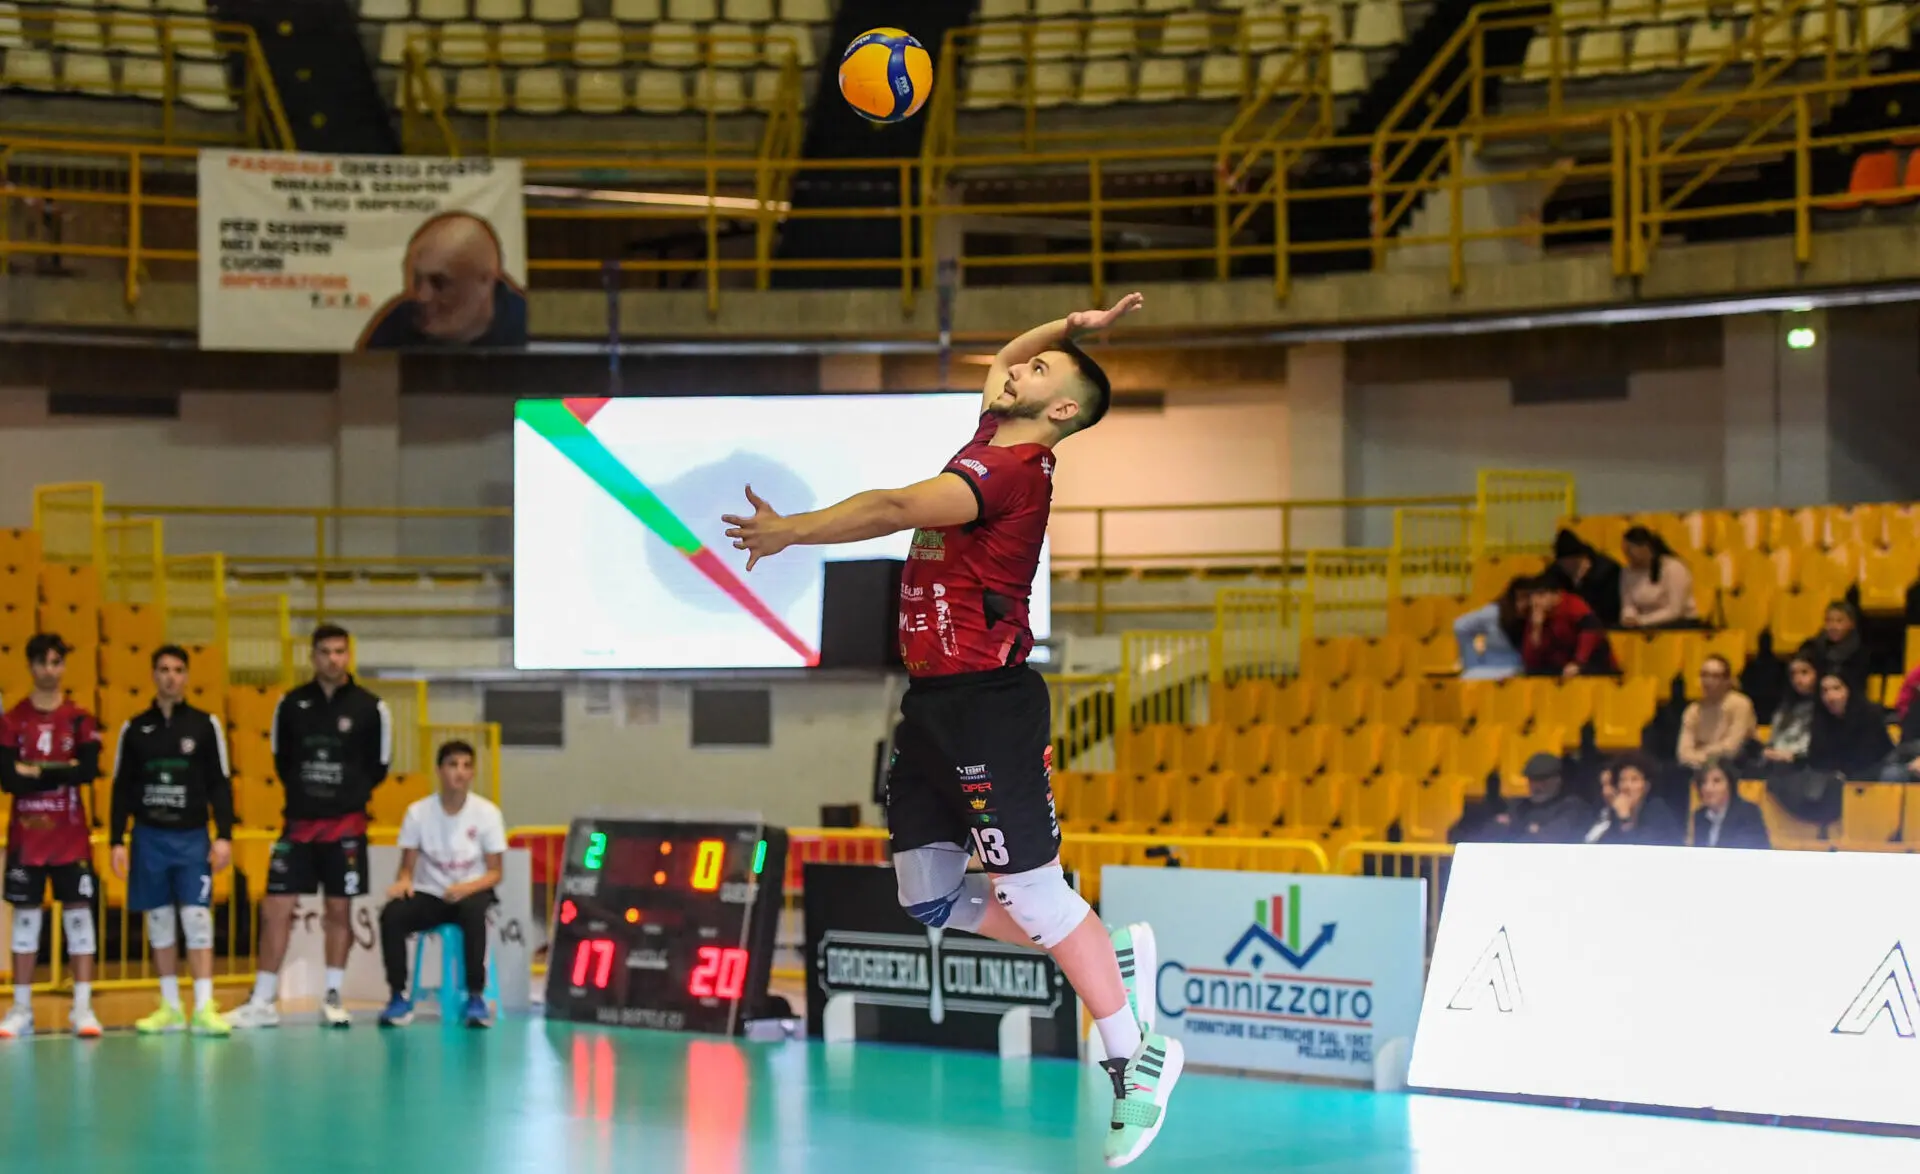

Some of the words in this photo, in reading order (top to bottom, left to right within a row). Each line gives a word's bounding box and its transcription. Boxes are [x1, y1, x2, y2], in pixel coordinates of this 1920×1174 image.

[219, 218, 258, 234] PER
[266, 221, 346, 238] SEMPRE
[37, 731, 52, 755] 4
[971, 827, 1010, 866] 13
[584, 832, 607, 870] 2
[691, 839, 724, 890] 0
[753, 839, 767, 874] 1
[78, 874, 93, 897] 4
[200, 874, 212, 898] 7
[344, 871, 360, 895] 2
[572, 939, 616, 989] 17
[690, 946, 749, 999] 20
[826, 948, 930, 990] DROGHERIA
[943, 957, 1049, 999] CULINARIA
[1156, 961, 1373, 1021] Cannizzaro
[1185, 1018, 1244, 1039] FORNITURE
[1248, 1023, 1314, 1045] ELETTRICHE
